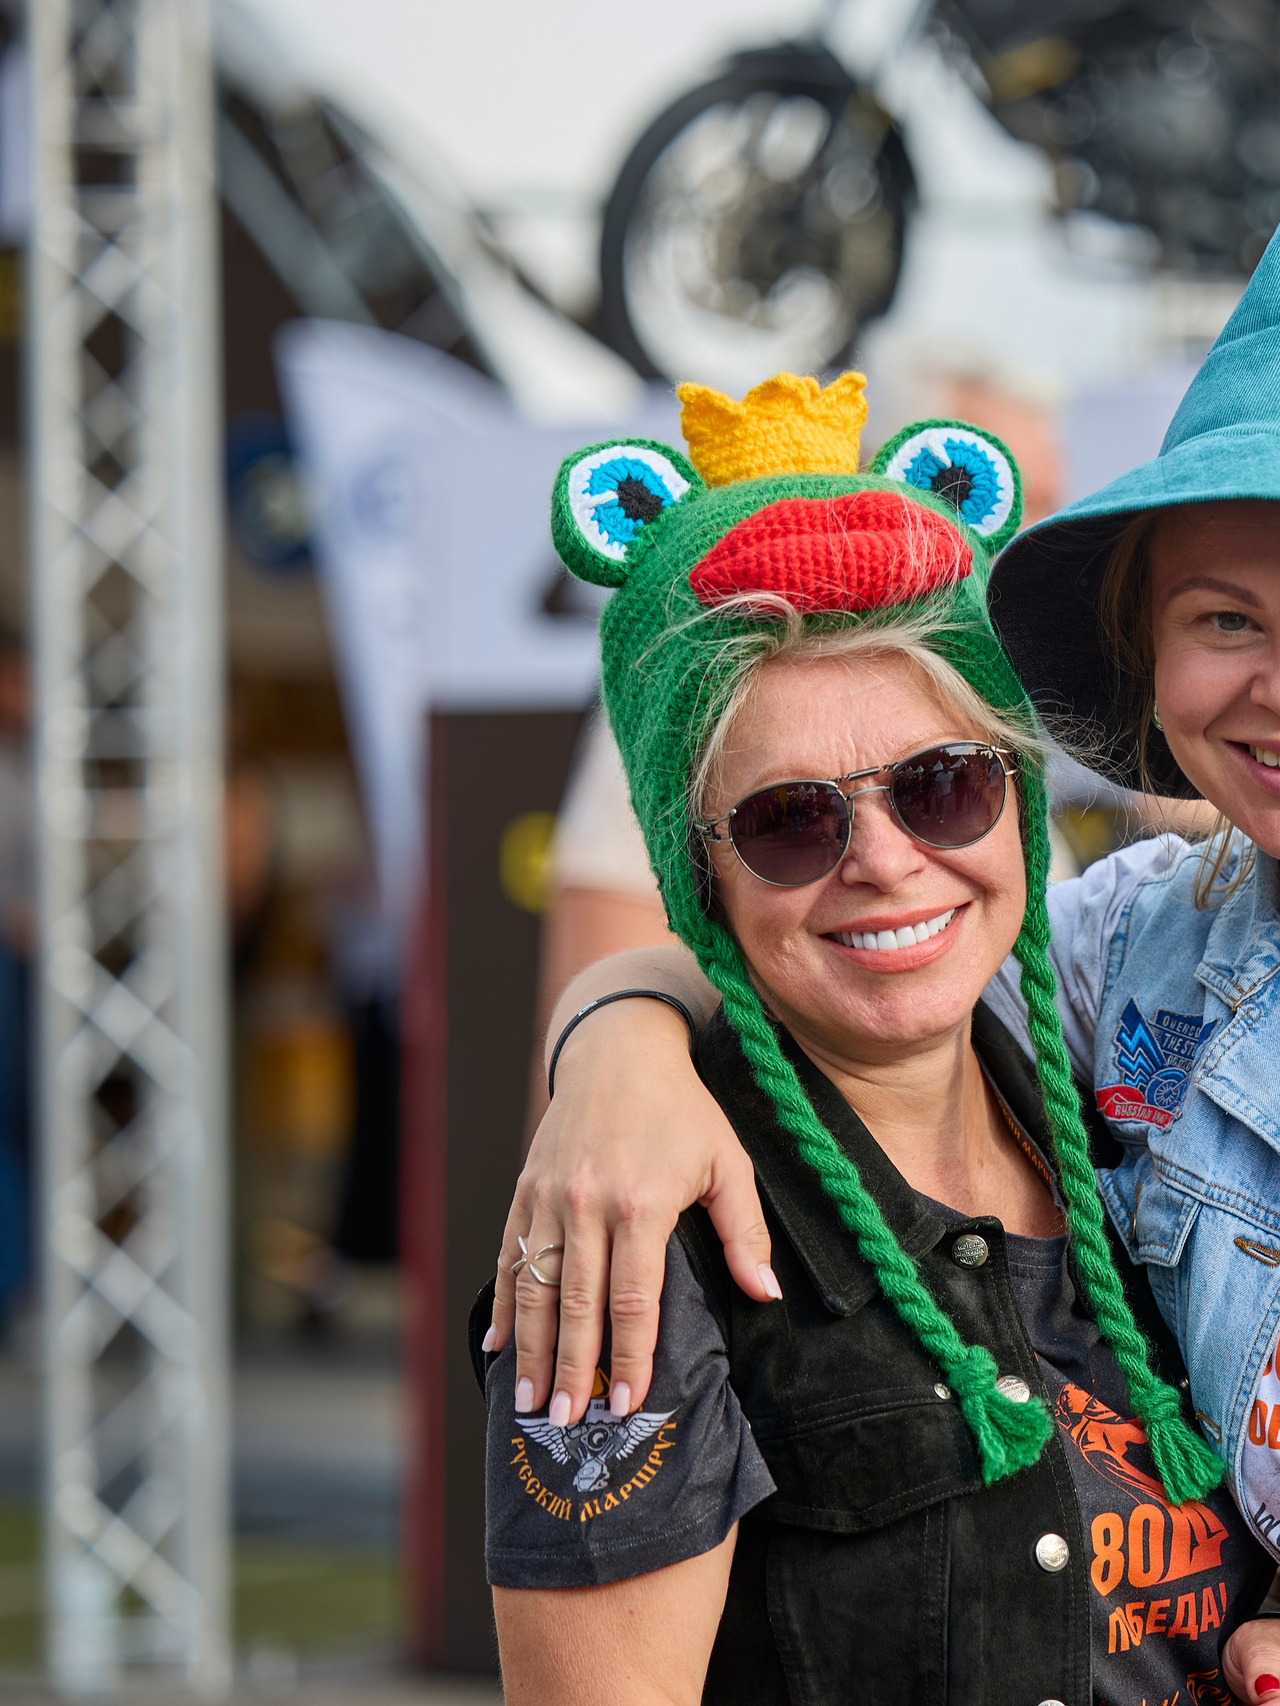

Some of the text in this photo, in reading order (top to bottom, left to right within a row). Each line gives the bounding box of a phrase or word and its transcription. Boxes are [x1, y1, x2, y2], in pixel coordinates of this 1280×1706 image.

[1162, 1032, 1183, 1052] THE
[1114, 1104, 1152, 1119] RUSSIAN
[509, 1420, 677, 1522] РУССКИЙ МАРШРУТ
